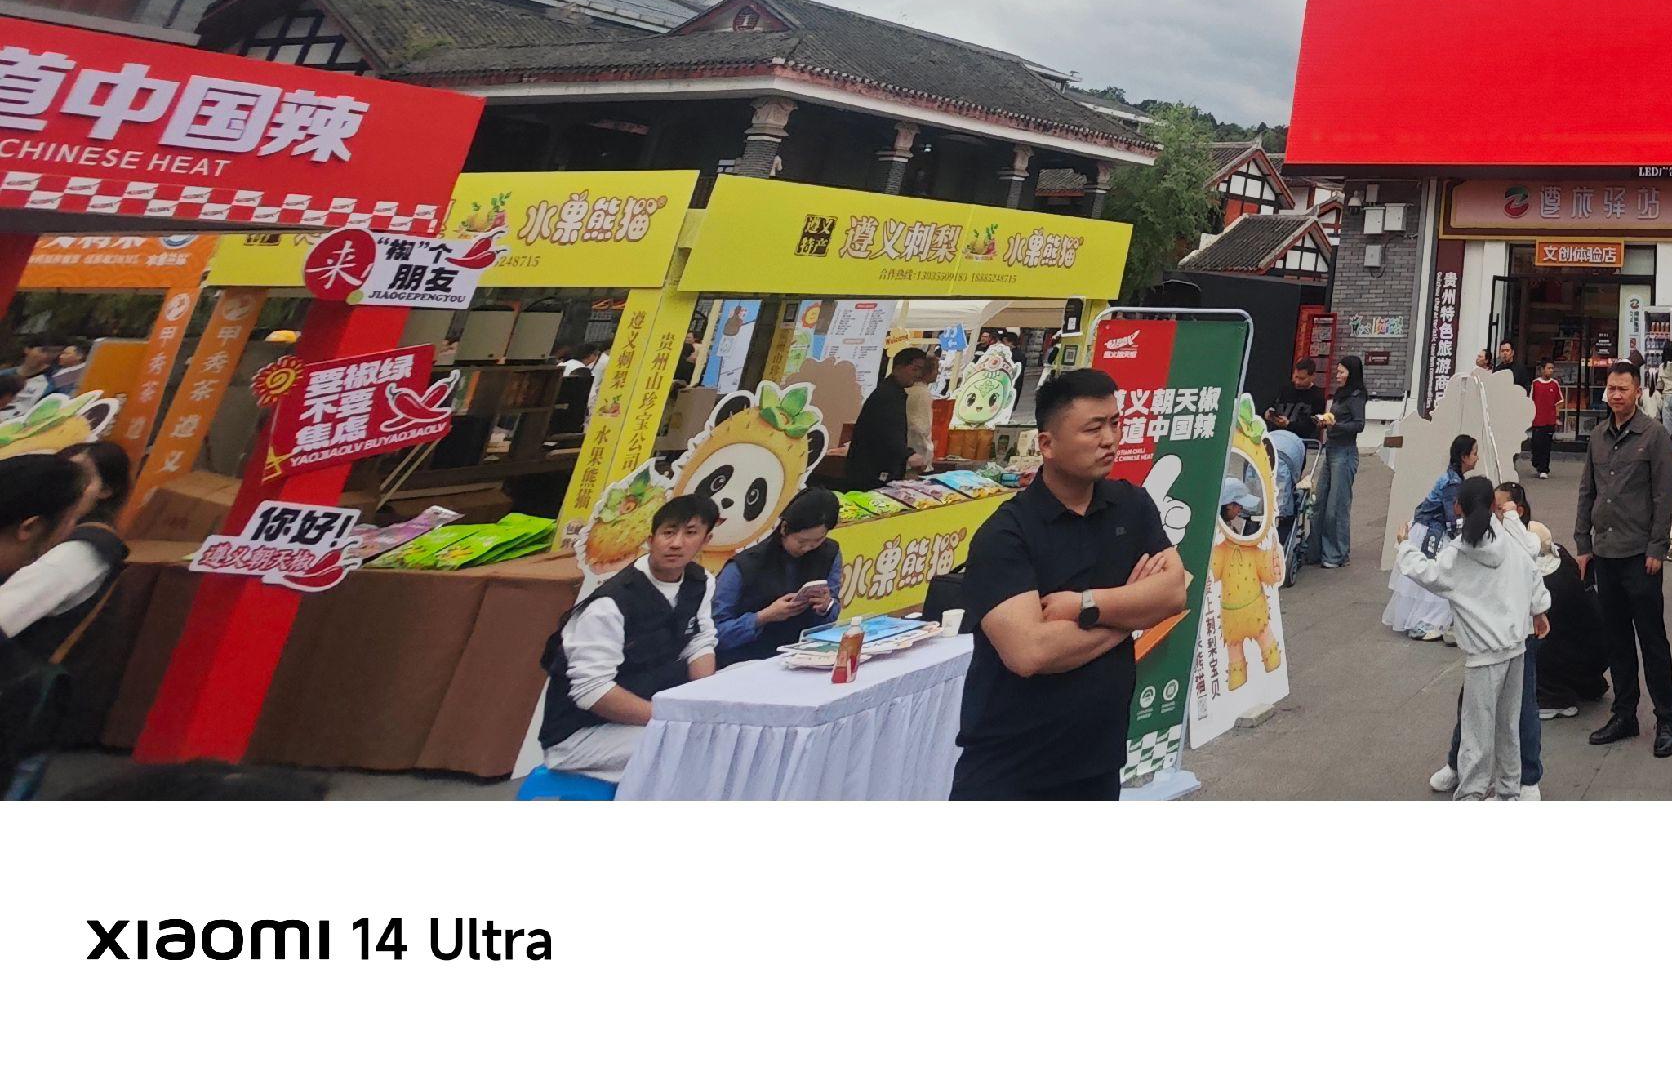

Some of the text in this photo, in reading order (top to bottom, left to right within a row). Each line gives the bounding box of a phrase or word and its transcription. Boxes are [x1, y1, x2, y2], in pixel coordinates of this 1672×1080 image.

[0, 139, 231, 177] CHINESE HEAT
[517, 190, 667, 245] 水果熊猫
[1540, 186, 1660, 219] 遵旅驿站
[803, 215, 835, 233] 遵义
[840, 216, 963, 263] 遵义刺梨
[799, 236, 829, 256] 特产
[1003, 228, 1084, 268] 水果熊猫
[1543, 246, 1617, 263] 文创体验店
[388, 264, 460, 293] 朋友
[610, 310, 645, 390] 遵义刺梨
[305, 354, 415, 398] 要椒绿
[300, 387, 377, 423] 不要
[622, 331, 675, 472] 贵州山珍宝公司
[291, 414, 370, 453] 焦虑
[1118, 412, 1217, 444] 道中国辣
[574, 425, 610, 510] 水果熊猫
[251, 506, 354, 547] 你好!
[198, 541, 316, 572] 遵义朝天椒
[838, 527, 967, 609] 水果熊猫
